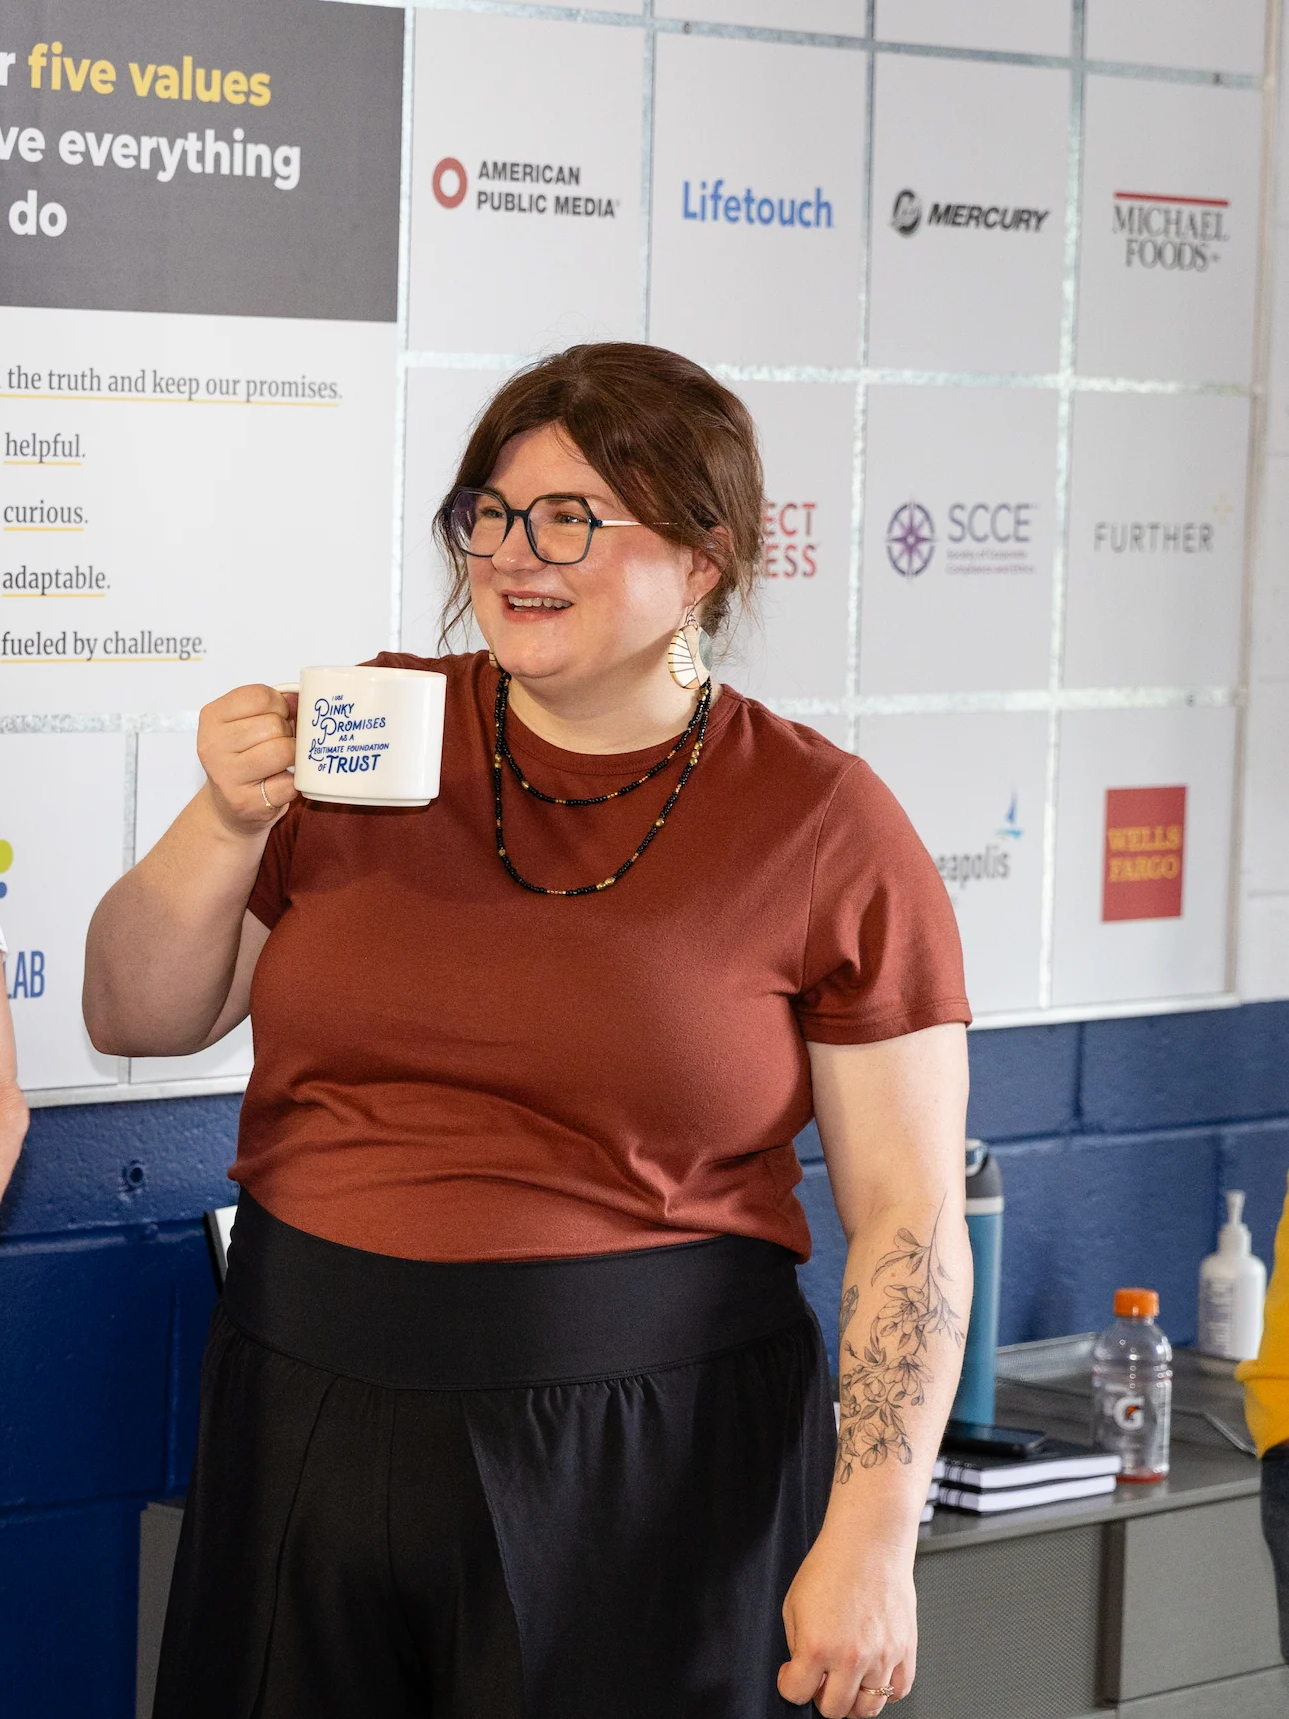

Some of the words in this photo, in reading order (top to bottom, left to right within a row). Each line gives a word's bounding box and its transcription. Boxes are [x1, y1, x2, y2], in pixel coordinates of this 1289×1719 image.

[28, 42, 116, 94] five
[130, 56, 272, 107] values
[58, 128, 301, 190] everything
[478, 160, 581, 186] AMERICAN
[9, 190, 68, 236] do
[477, 191, 547, 214] PUBLIC
[554, 195, 616, 218] MEDIA
[682, 179, 833, 229] Lifetouch
[927, 203, 1050, 233] MERCURY
[1112, 205, 1230, 242] MICHAEL
[1125, 238, 1209, 273] FOODS
[8, 365, 42, 390] the
[48, 368, 102, 392] truth
[108, 369, 146, 393] and
[152, 369, 200, 401] keep
[206, 378, 241, 396] our
[246, 375, 342, 402] promises.
[5, 432, 86, 464] helpful.
[3, 499, 88, 524] curious.
[947, 502, 1031, 544] SCCE
[1093, 521, 1216, 554] FURTHER
[2, 565, 111, 596] adaptable.
[1, 631, 67, 656] fueled
[73, 631, 98, 661] by
[103, 630, 207, 661] challenge.
[312, 698, 355, 726] PINKY
[317, 717, 386, 745] PROMISES
[339, 734, 348, 742] AS
[308, 739, 345, 762] LEGITIMATE
[347, 743, 390, 752] FOUNDATION
[318, 763, 327, 772] OF
[326, 754, 381, 774] TRUST
[1107, 824, 1181, 852] WELLS
[1109, 854, 1180, 882] FARGO
